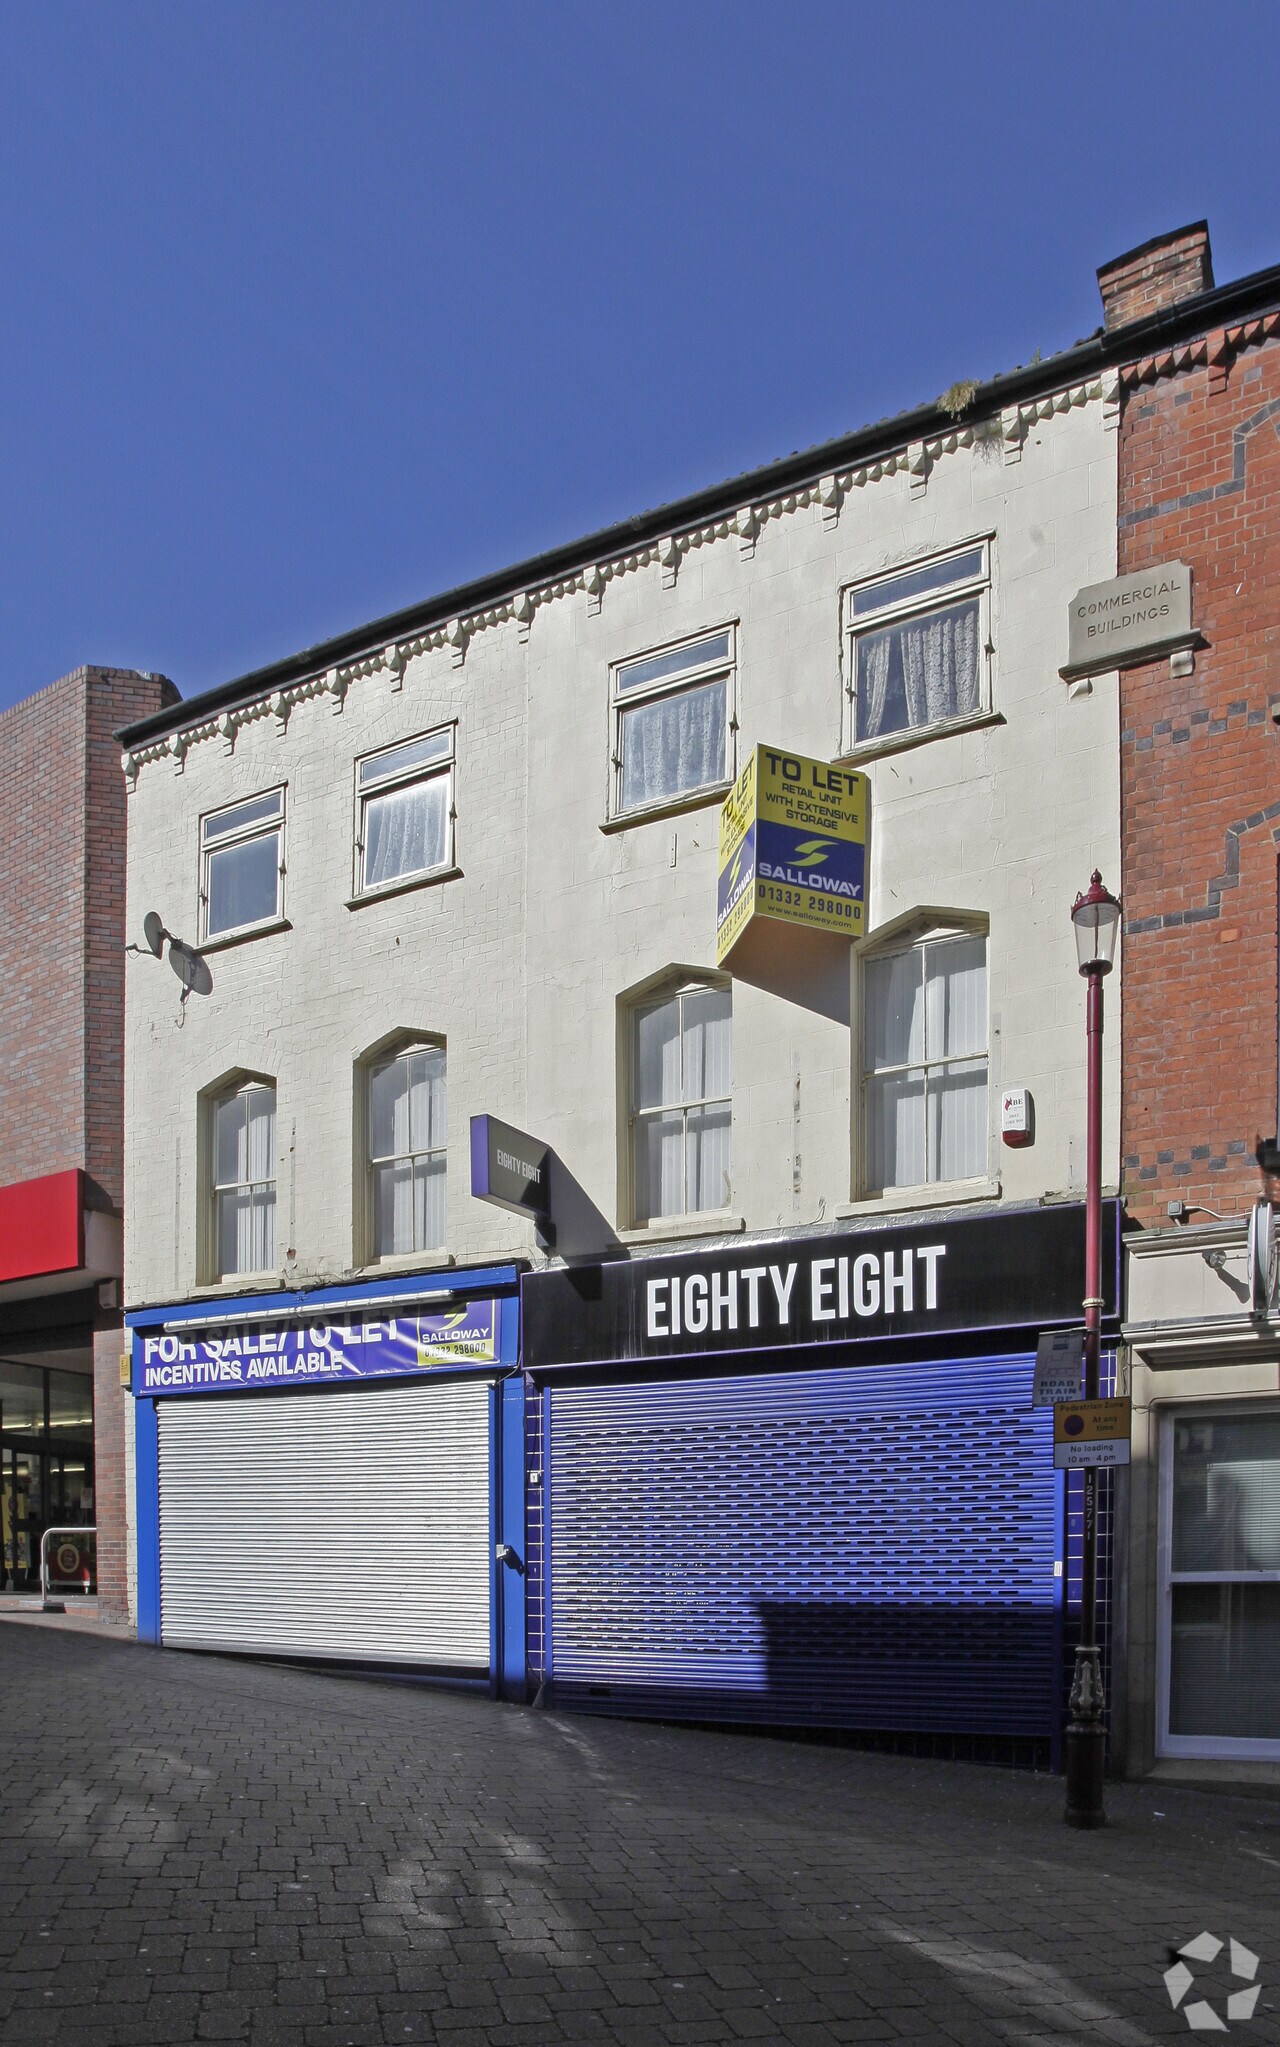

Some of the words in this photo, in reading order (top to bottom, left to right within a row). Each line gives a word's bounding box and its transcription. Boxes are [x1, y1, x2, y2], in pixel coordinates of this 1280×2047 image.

[1077, 579, 1181, 618] COMMERCIAL
[737, 755, 754, 803] LET
[765, 752, 801, 782] TO
[812, 765, 859, 796] LET
[765, 792, 793, 807] WITH
[798, 801, 858, 824] EXTENSIVE
[782, 783, 816, 800] RETAIL
[819, 792, 842, 806] UNIT
[786, 810, 838, 830] STORAGE
[759, 862, 861, 897] SALLOWAY
[718, 863, 754, 929] SALLOWAY
[759, 884, 801, 906] 01332
[809, 896, 861, 920] 298000
[767, 904, 852, 928] www.salloway.com
[497, 1149, 520, 1174] EIGHTY
[522, 1161, 541, 1183] EIGHT
[646, 1262, 797, 1338] EIGHTY
[811, 1245, 946, 1321] EIGHT
[144, 1331, 197, 1364] FOR
[342, 1306, 405, 1345] LET
[422, 1327, 489, 1343] SALLOWAY
[454, 1342, 486, 1355] 298000
[145, 1360, 242, 1387] INCENTIVES
[246, 1350, 344, 1379] AVAILABLE
[1039, 1387, 1077, 1395] TRAIN
[1060, 1403, 1102, 1411] Pedestrian
[1105, 1401, 1124, 1409] Zone
[1103, 1416, 1118, 1425] any
[1084, 1444, 1113, 1453] loading
[1096, 1454, 1102, 1462] 4
